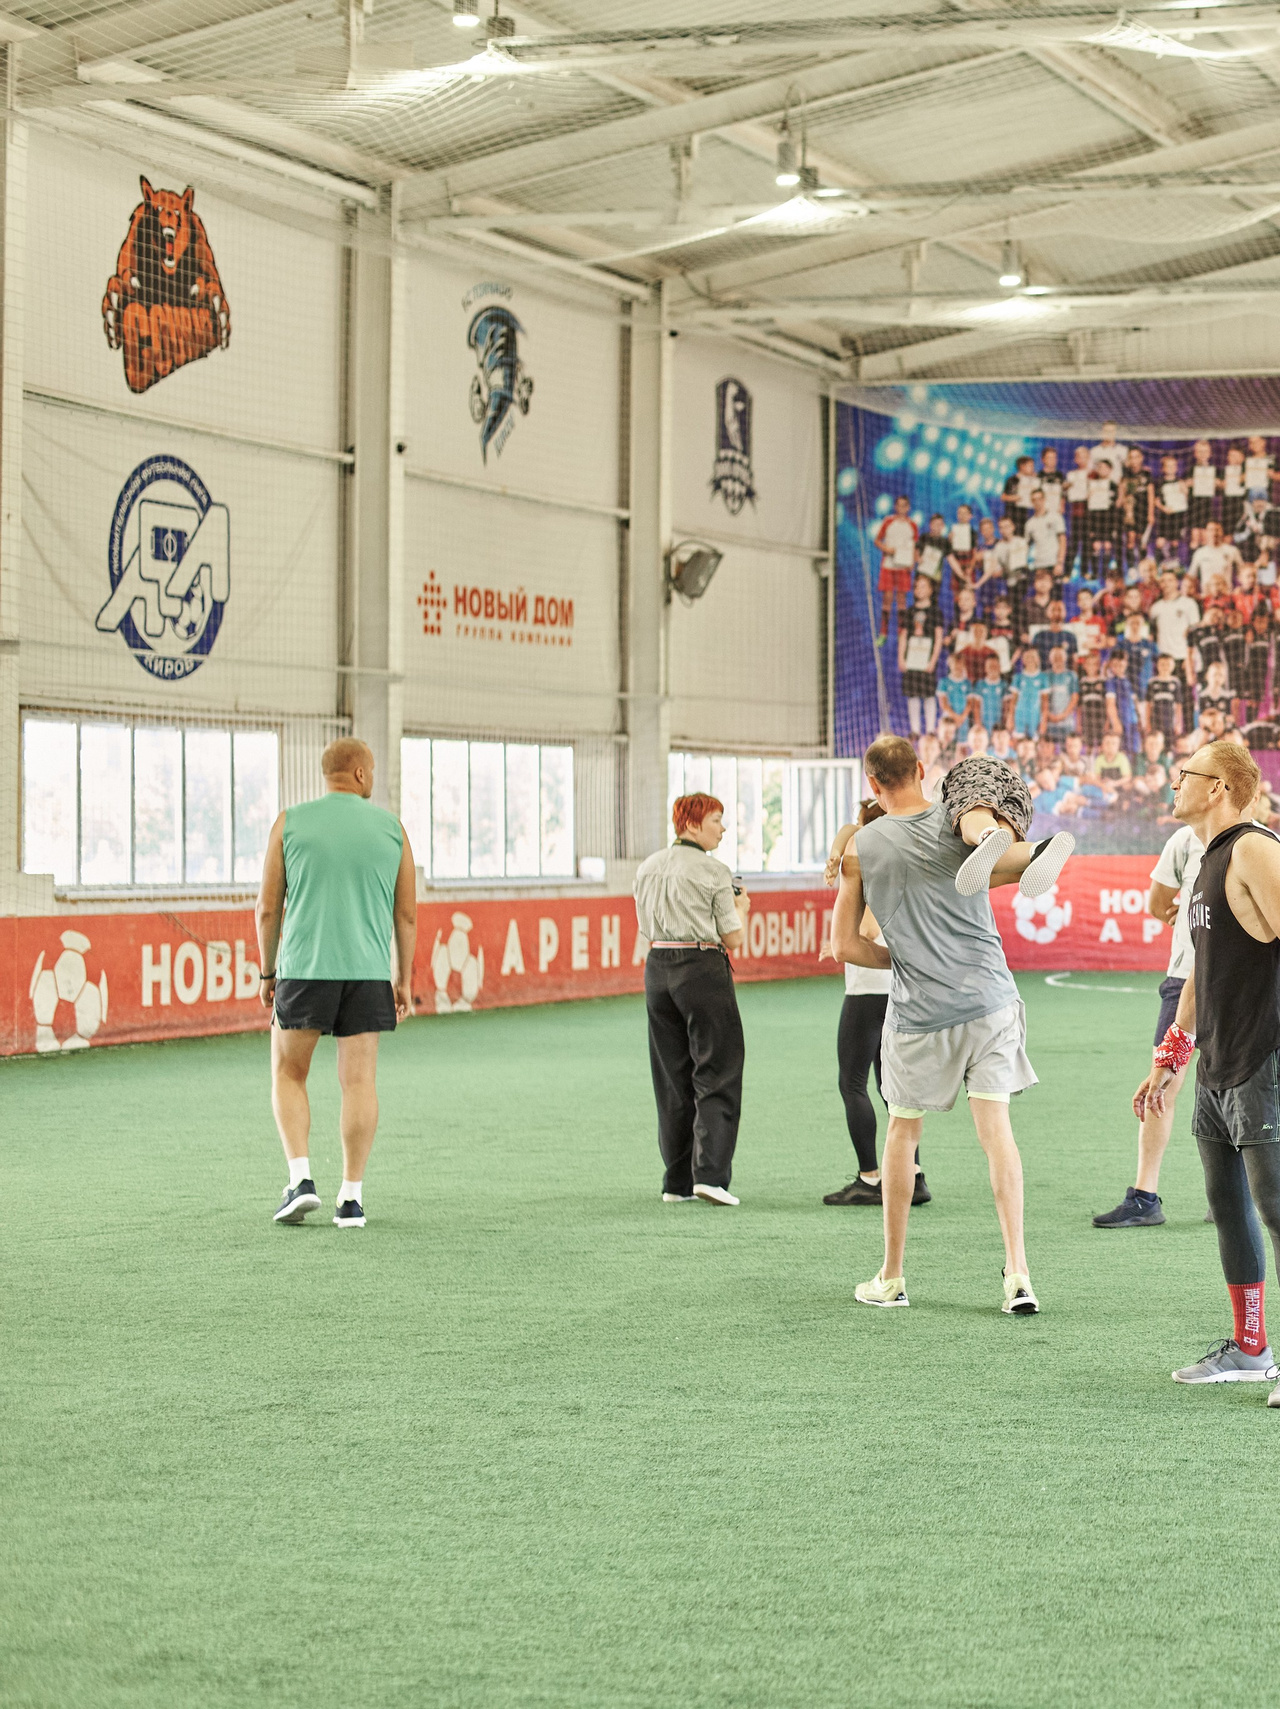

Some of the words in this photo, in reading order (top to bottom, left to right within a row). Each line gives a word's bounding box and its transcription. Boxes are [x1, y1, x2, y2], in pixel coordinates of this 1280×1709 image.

[454, 584, 528, 624] НОВЫЙ
[533, 595, 575, 629] ДОМ
[144, 655, 195, 677] КИРОВ
